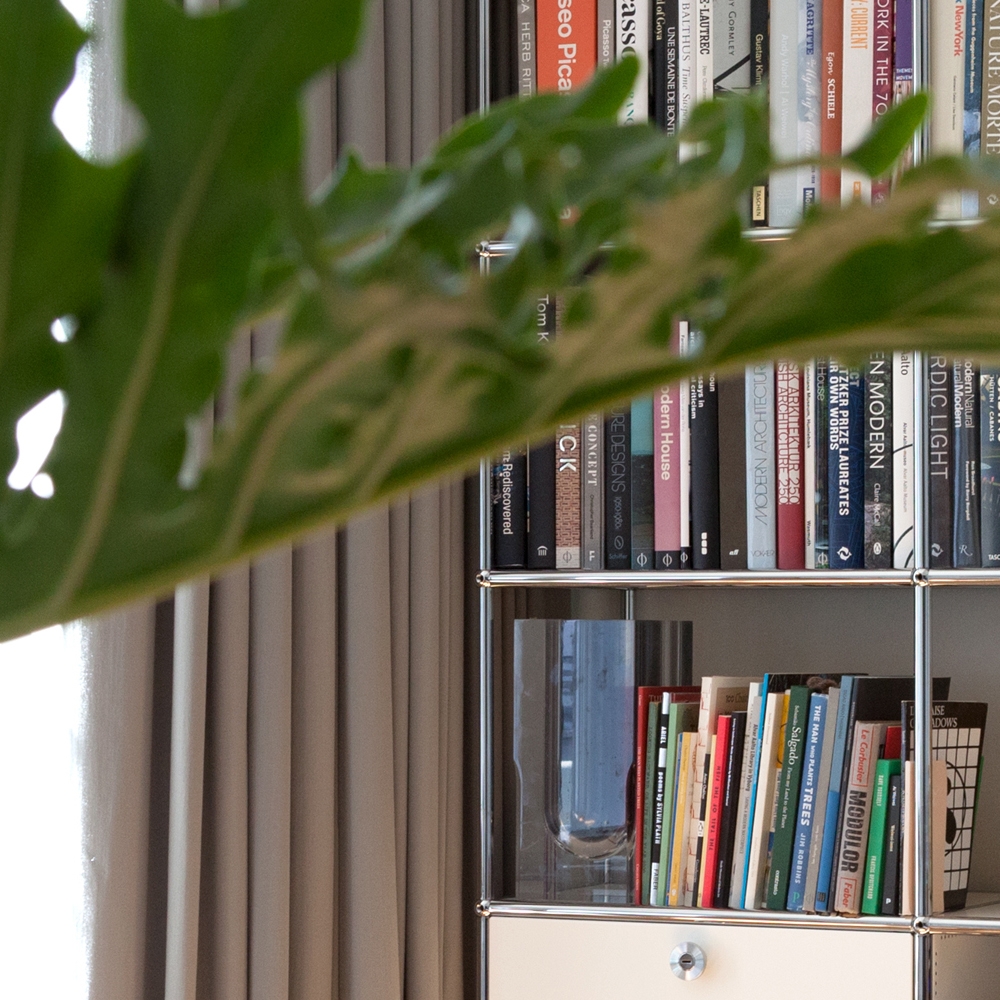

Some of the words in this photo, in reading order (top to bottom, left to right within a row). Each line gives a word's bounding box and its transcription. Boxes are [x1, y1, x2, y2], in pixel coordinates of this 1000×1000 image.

[521, 22, 531, 61] HERB
[602, 20, 611, 56] Picasso
[682, 3, 691, 61] BALTHUS
[728, 11, 737, 56] GORMLEY
[755, 34, 764, 63] Gustav
[850, 7, 868, 49] CURRENT
[876, 36, 889, 51] IN
[876, 58, 889, 85] THE
[827, 78, 836, 119] SCHIELE
[830, 376, 838, 404] OWN
[788, 387, 799, 471] ARKITEKTUR
[830, 407, 839, 450] WORDS
[839, 410, 849, 445] PRIZE
[869, 382, 885, 469] MODERN
[588, 425, 598, 486] CONCEPT
[611, 435, 626, 492] DESIGNS
[661, 433, 674, 480] House
[930, 414, 948, 479] LIGHT
[502, 463, 513, 535] Rediscovered
[754, 459, 768, 526] MODERN
[839, 448, 849, 516] LAUREATES
[811, 723, 820, 743] MAN
[812, 705, 822, 721] THE
[787, 726, 802, 765] Salgado
[856, 741, 868, 782] Corbusier
[657, 772, 665, 792] poems
[806, 759, 815, 786] PLANTS
[801, 787, 814, 826] TREES
[840, 790, 867, 873] MODULOR
[795, 849, 804, 884] ROBBINS
[842, 881, 852, 908] Faber
